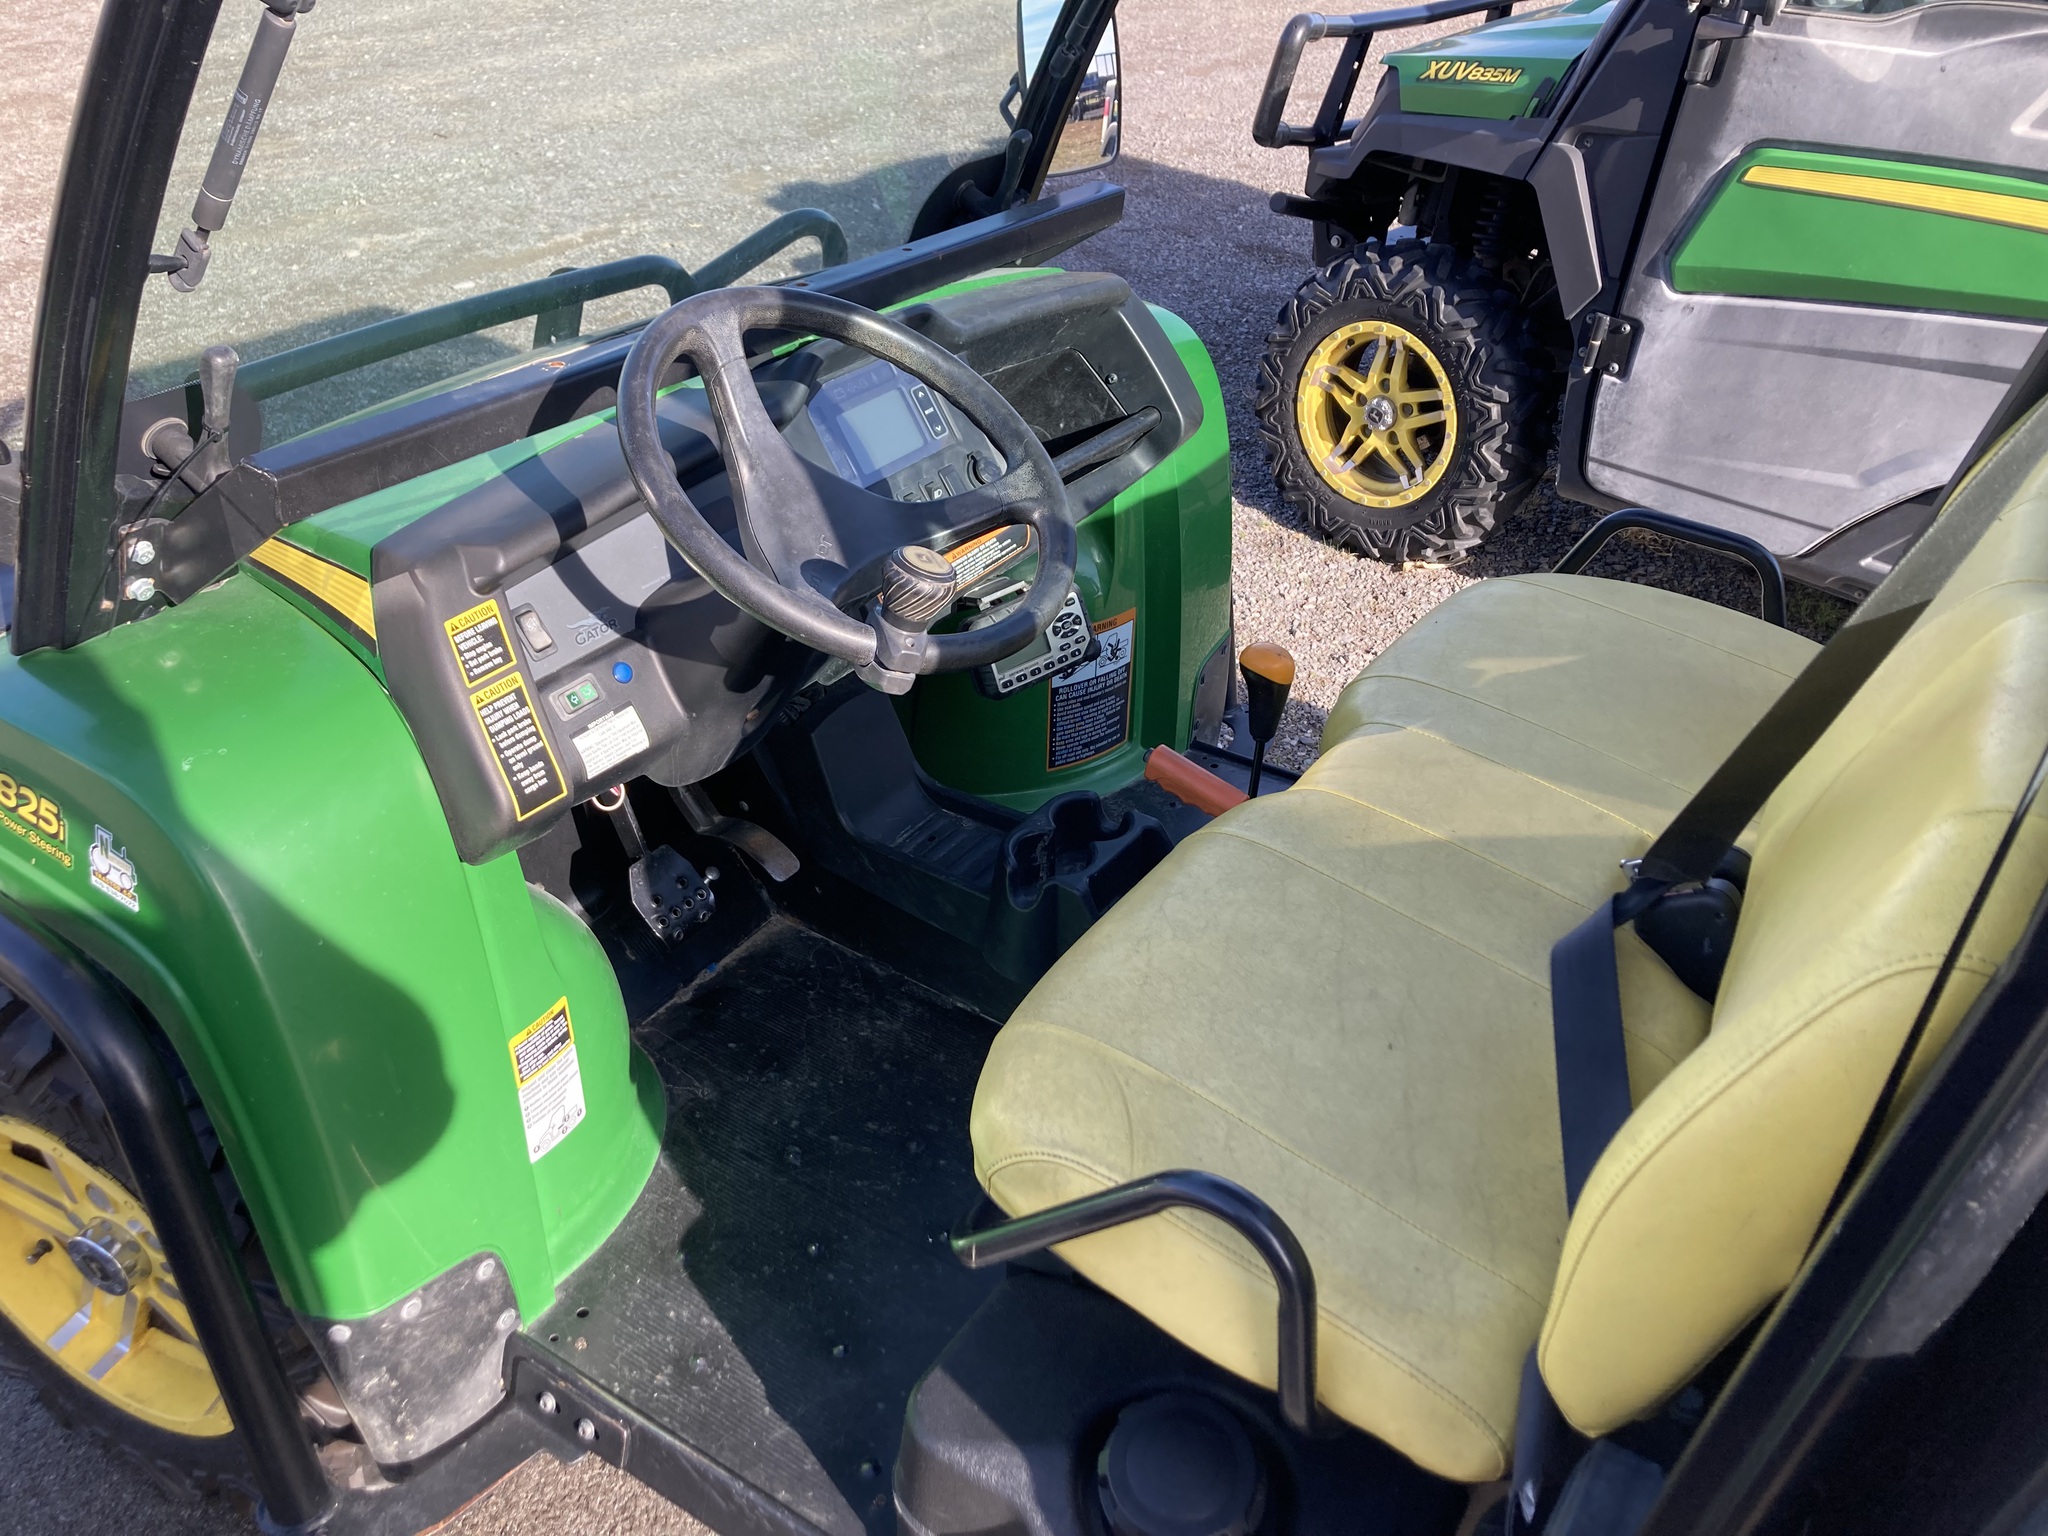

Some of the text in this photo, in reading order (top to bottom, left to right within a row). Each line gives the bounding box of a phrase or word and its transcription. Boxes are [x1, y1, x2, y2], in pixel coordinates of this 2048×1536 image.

[1419, 60, 1523, 83] XUV835M
[956, 539, 982, 557] WARNING
[458, 604, 494, 628] CAUTION
[1092, 617, 1118, 632] ARNING
[453, 616, 498, 644] BEFORE LEAVING
[575, 619, 618, 645] GATOR
[458, 634, 485, 652] VEHICLE:
[483, 675, 519, 700] CAUTION
[1055, 672, 1128, 702] CAN CAUSE INJURY OR DEATH
[1058, 682, 1088, 694] ROLLOVER
[1089, 679, 1096, 687] OR
[1098, 670, 1117, 683] FALLING
[479, 692, 517, 717] HELP PREVENT
[483, 701, 520, 725] INJURY WHEN
[488, 705, 531, 733] DUMPING LOADS
[587, 710, 615, 730] IMPORTANT
[0, 811, 72, 868] Power Steering
[532, 1009, 555, 1032] CAUTION
